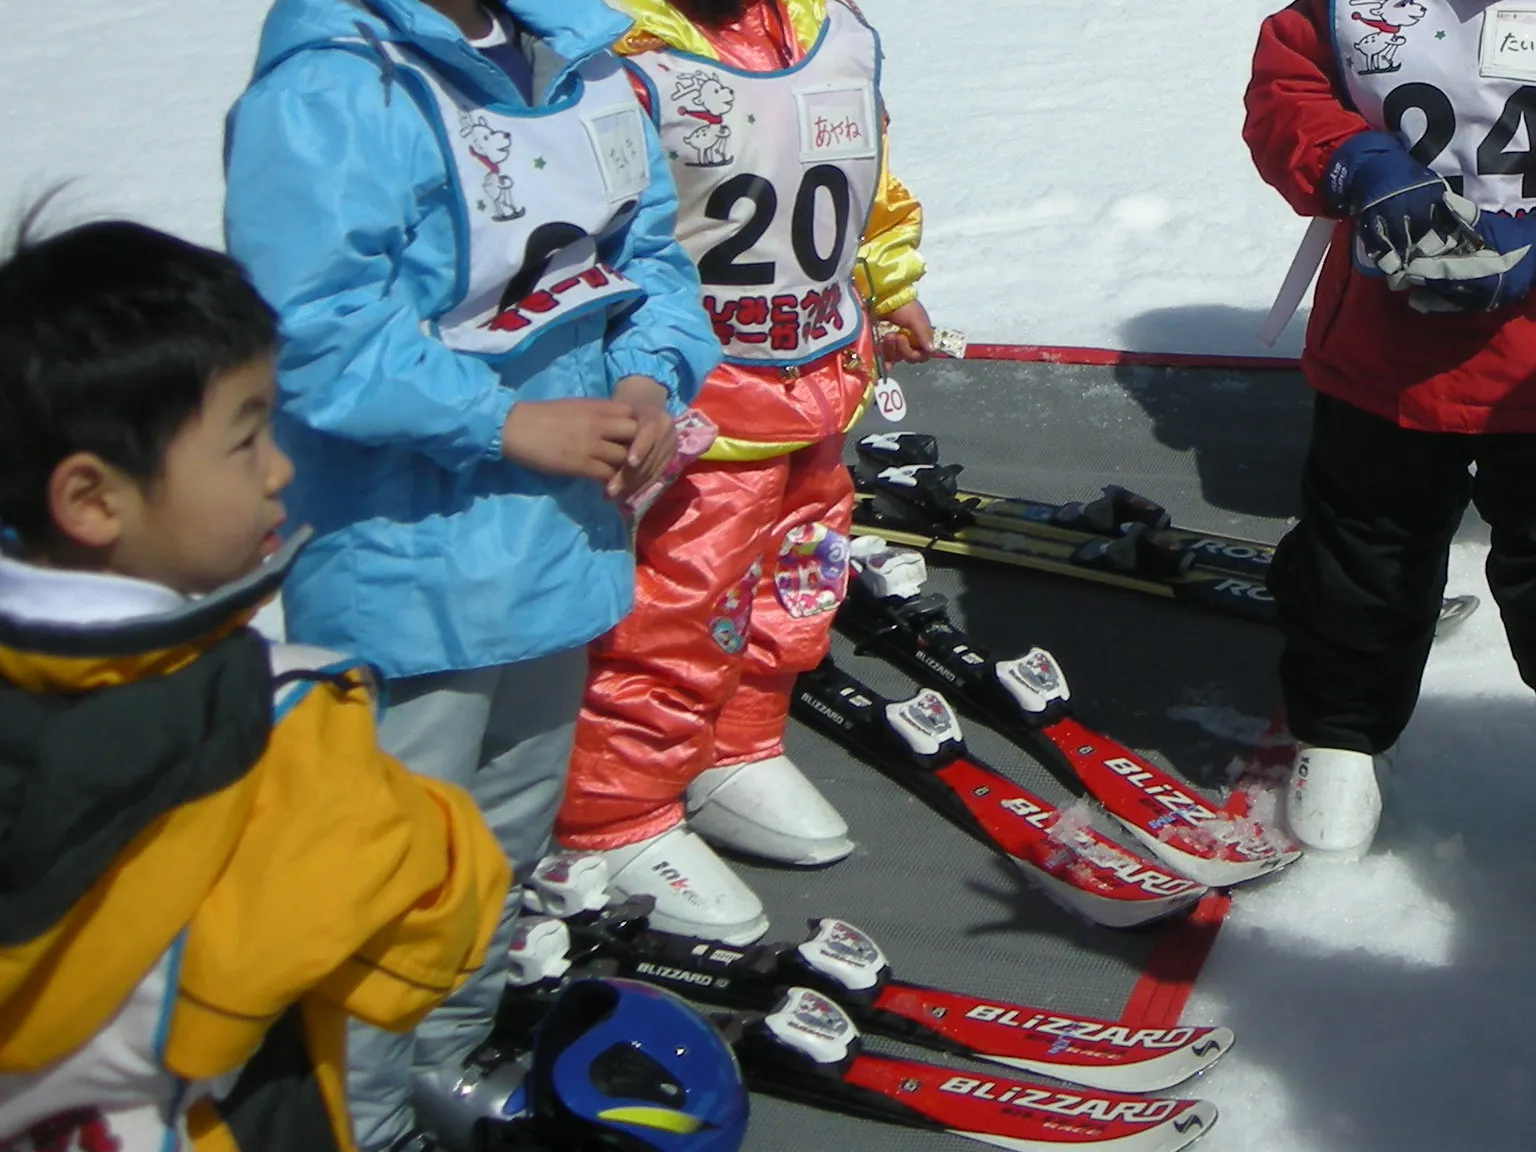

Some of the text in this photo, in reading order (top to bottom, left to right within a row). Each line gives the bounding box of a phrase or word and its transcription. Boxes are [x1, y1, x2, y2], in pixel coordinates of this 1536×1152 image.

[698, 164, 850, 285] 20
[878, 388, 904, 414] 20
[915, 650, 956, 683] BLIZZARD
[801, 692, 844, 725] BLIZZARD
[637, 961, 713, 986] BLIZZARD
